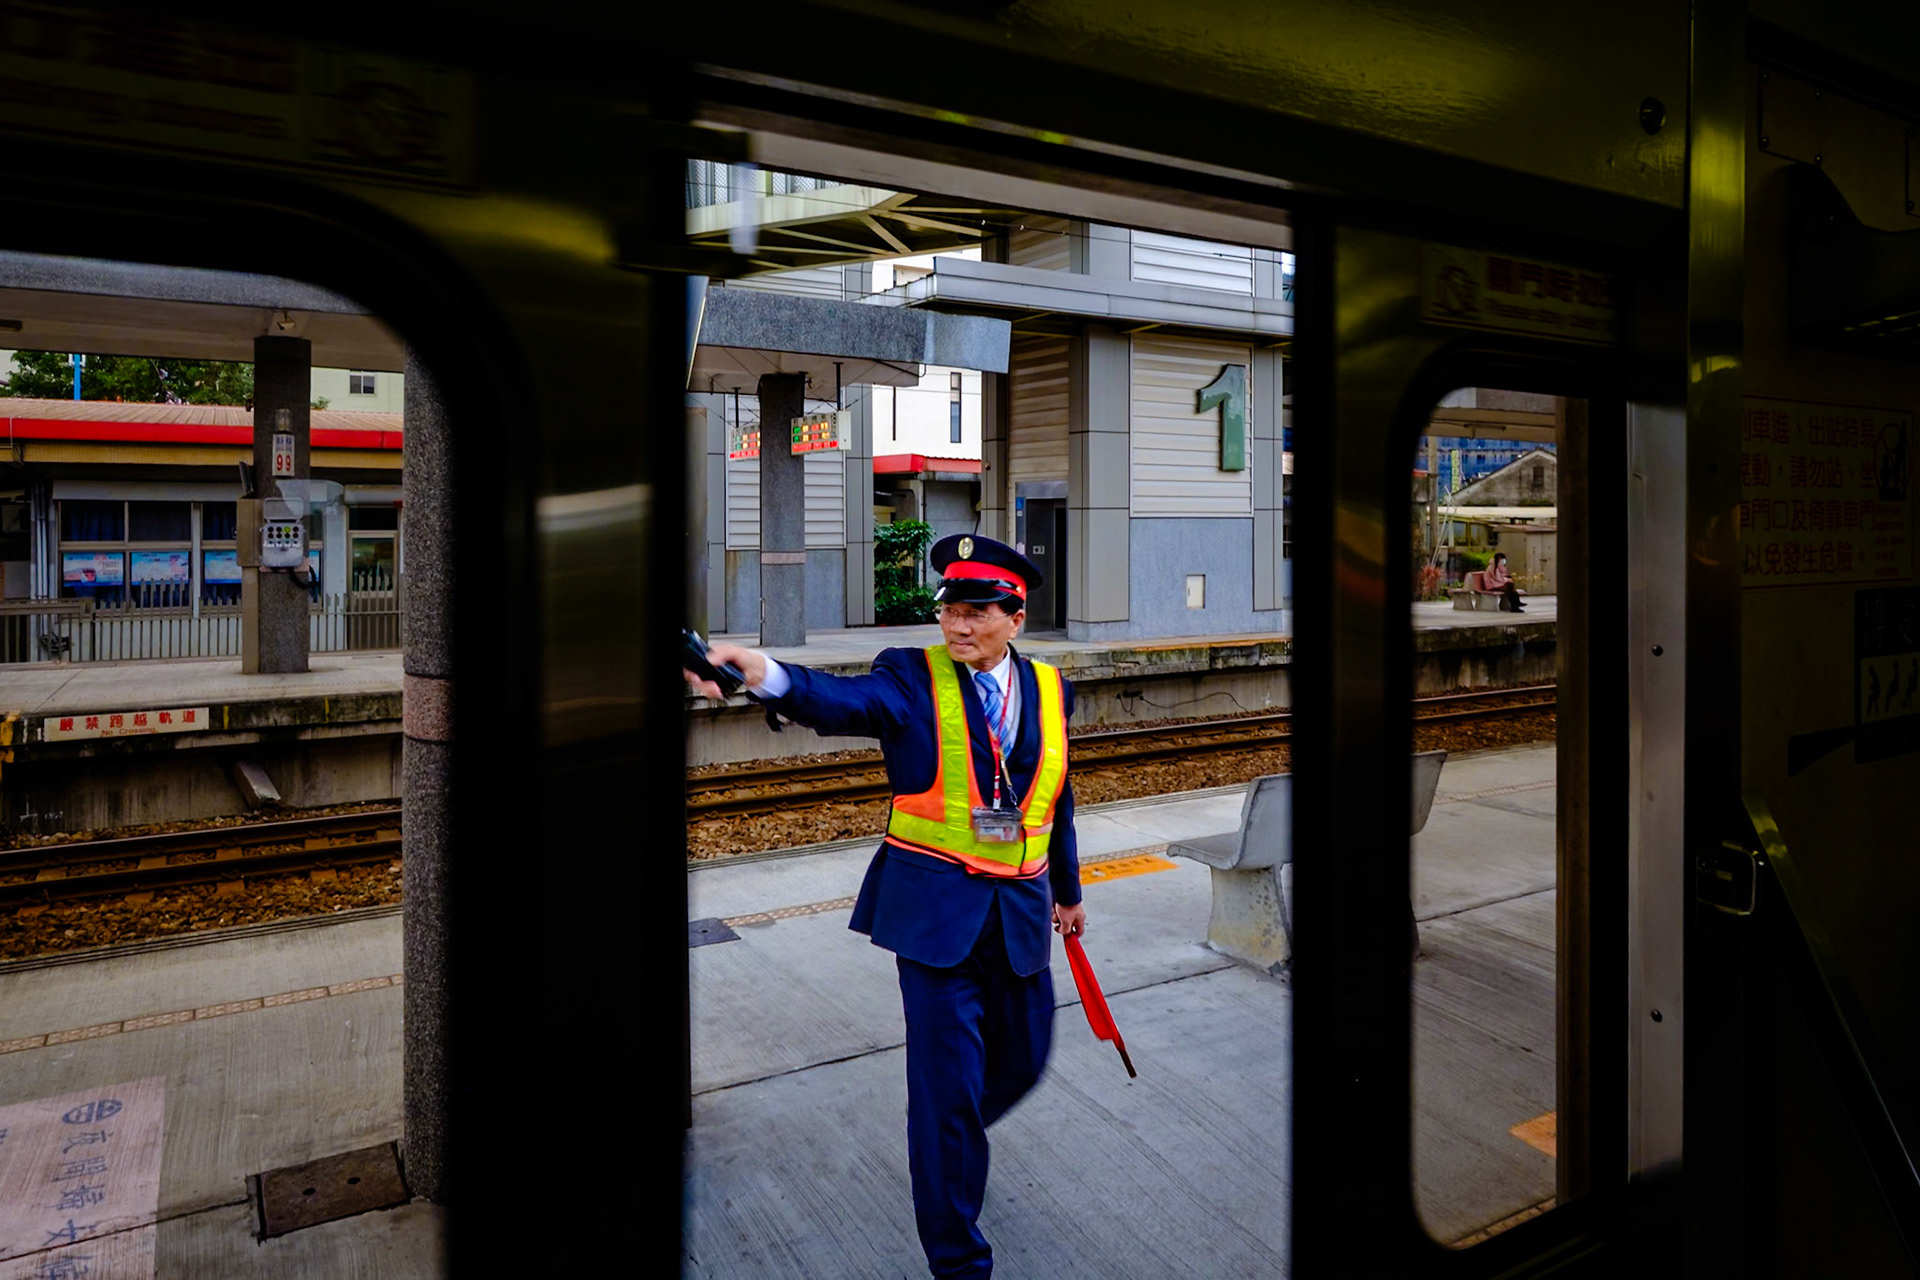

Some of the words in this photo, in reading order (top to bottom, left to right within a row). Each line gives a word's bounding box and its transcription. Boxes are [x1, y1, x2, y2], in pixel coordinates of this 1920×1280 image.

[1195, 363, 1245, 471] 1
[277, 454, 291, 471] 99
[59, 710, 196, 732] 嚴禁跨越軌道
[101, 729, 114, 737] No
